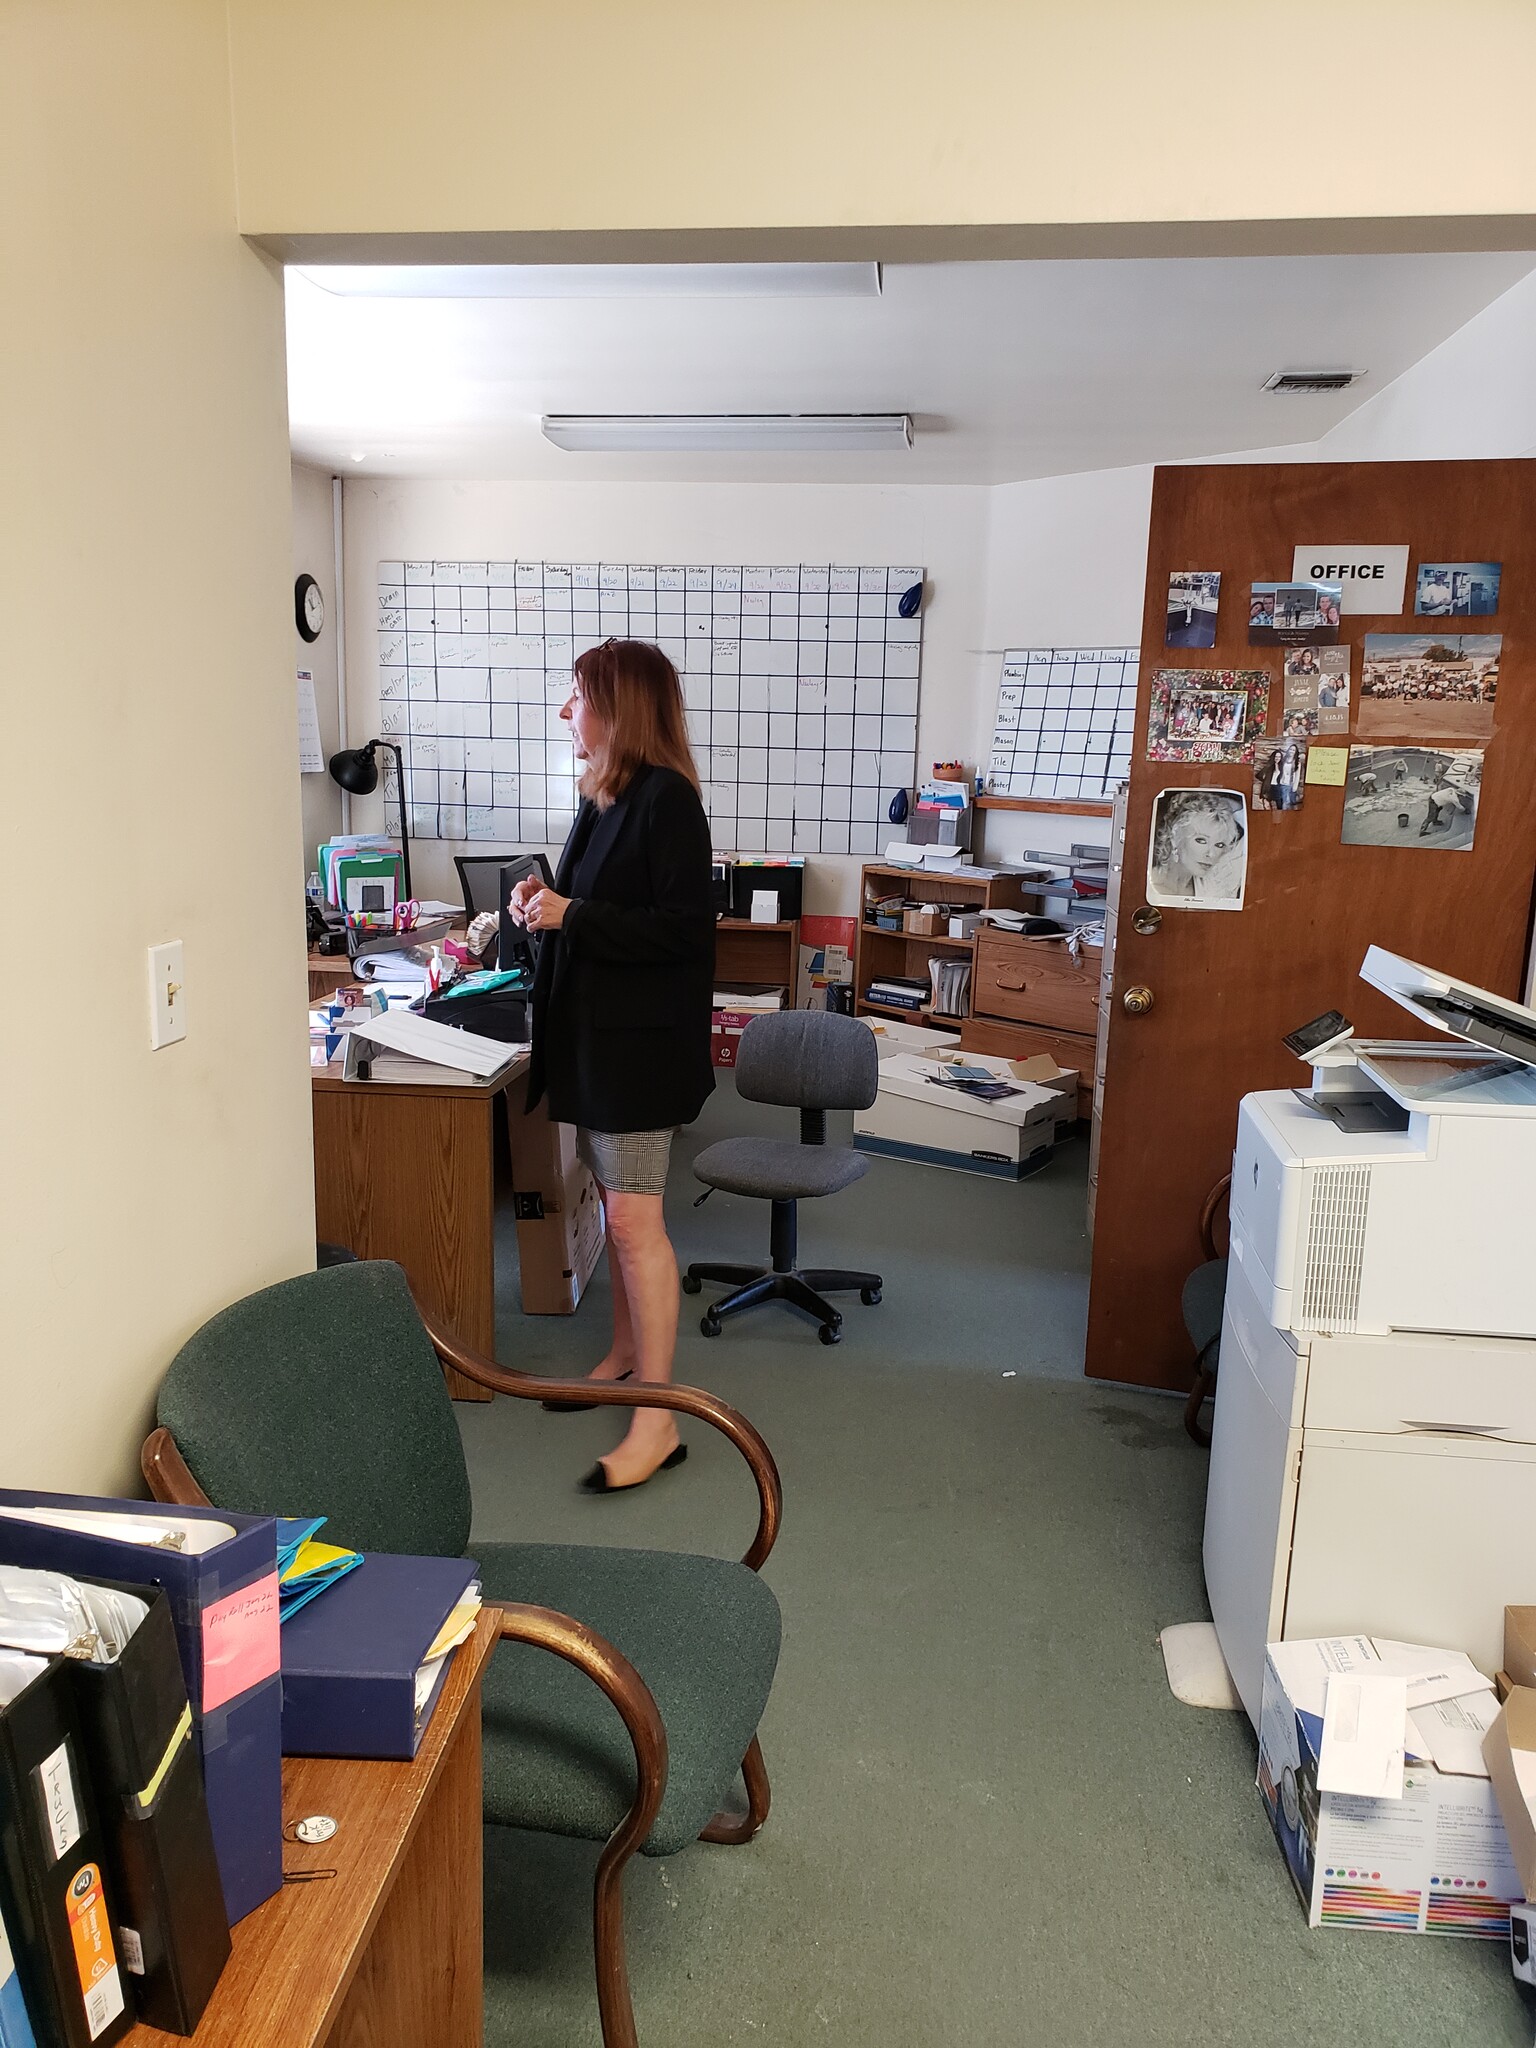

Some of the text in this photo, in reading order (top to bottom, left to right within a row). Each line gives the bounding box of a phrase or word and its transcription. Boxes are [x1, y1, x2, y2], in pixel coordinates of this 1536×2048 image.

[1310, 564, 1385, 579] OFFICE
[1001, 691, 1016, 701] Prep
[998, 713, 1016, 723] Blast
[994, 736, 1014, 745] Mason
[992, 757, 1007, 767] Tile
[988, 778, 1010, 789] Plaster
[87, 1907, 101, 1934] Heavy
